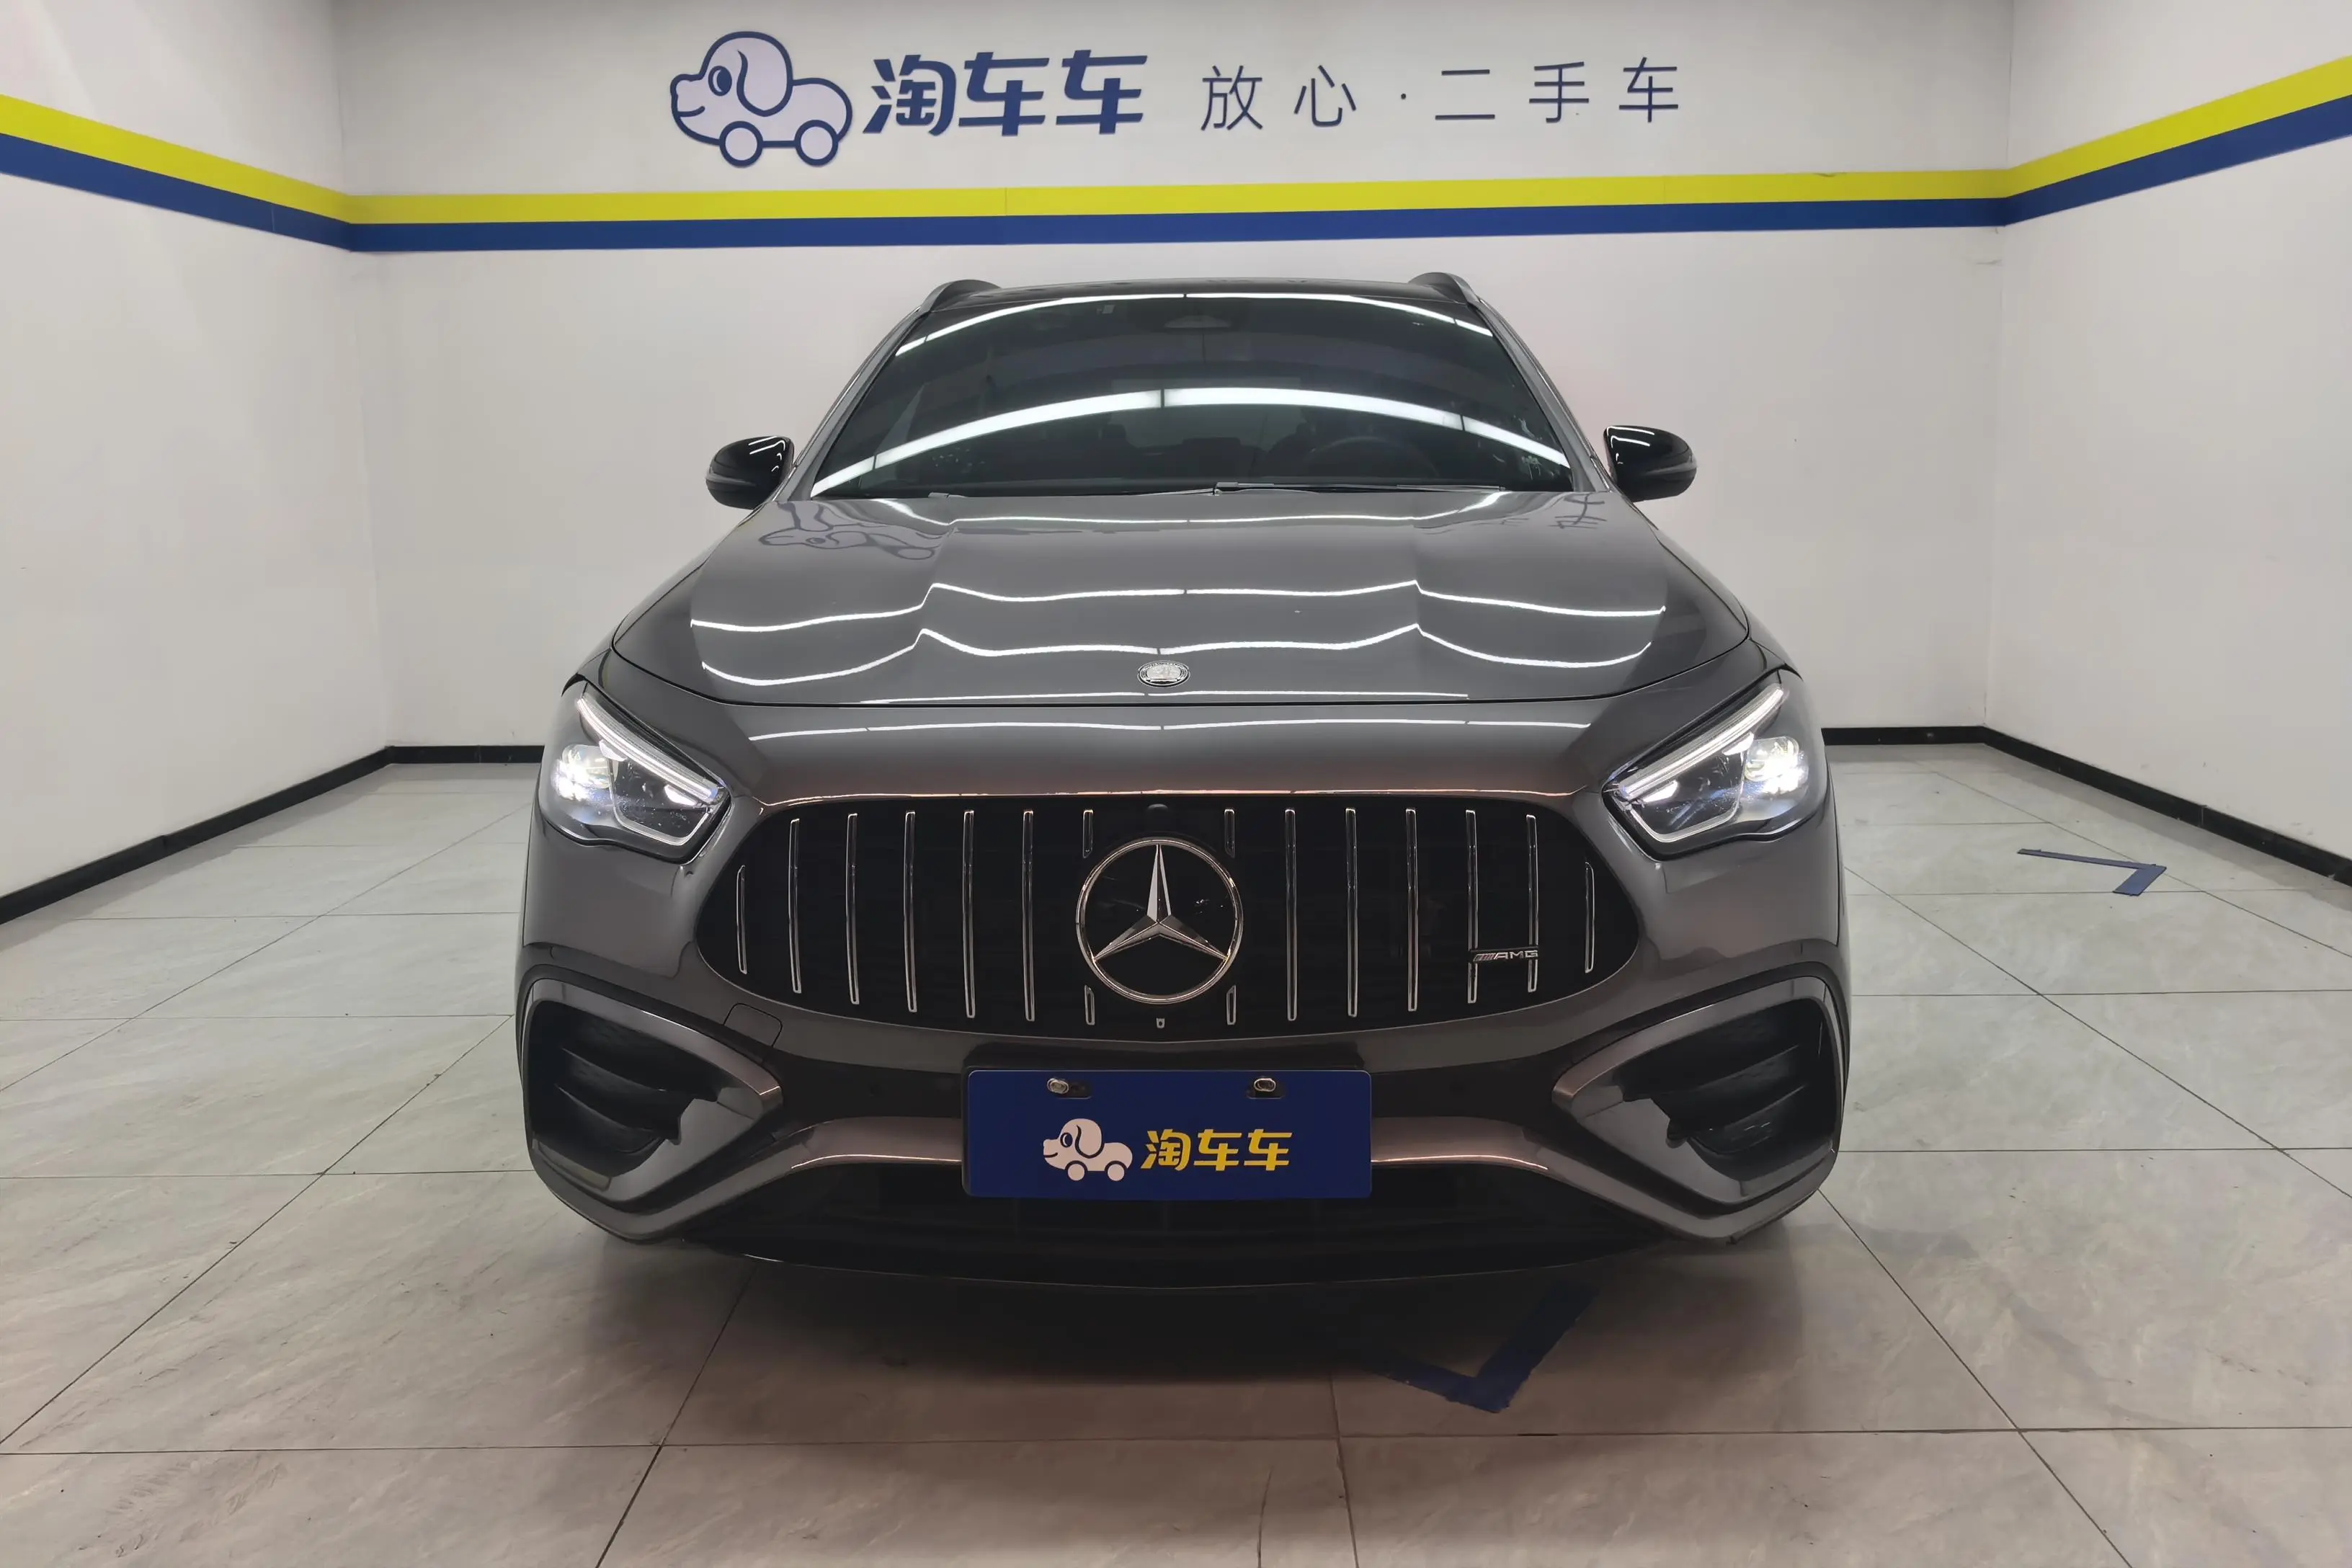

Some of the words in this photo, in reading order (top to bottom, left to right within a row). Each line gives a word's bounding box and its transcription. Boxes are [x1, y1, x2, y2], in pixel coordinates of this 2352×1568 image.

[863, 50, 1148, 136] 淘车车
[1492, 950, 1538, 960] AMG
[1141, 1128, 1293, 1172] 淘车车
